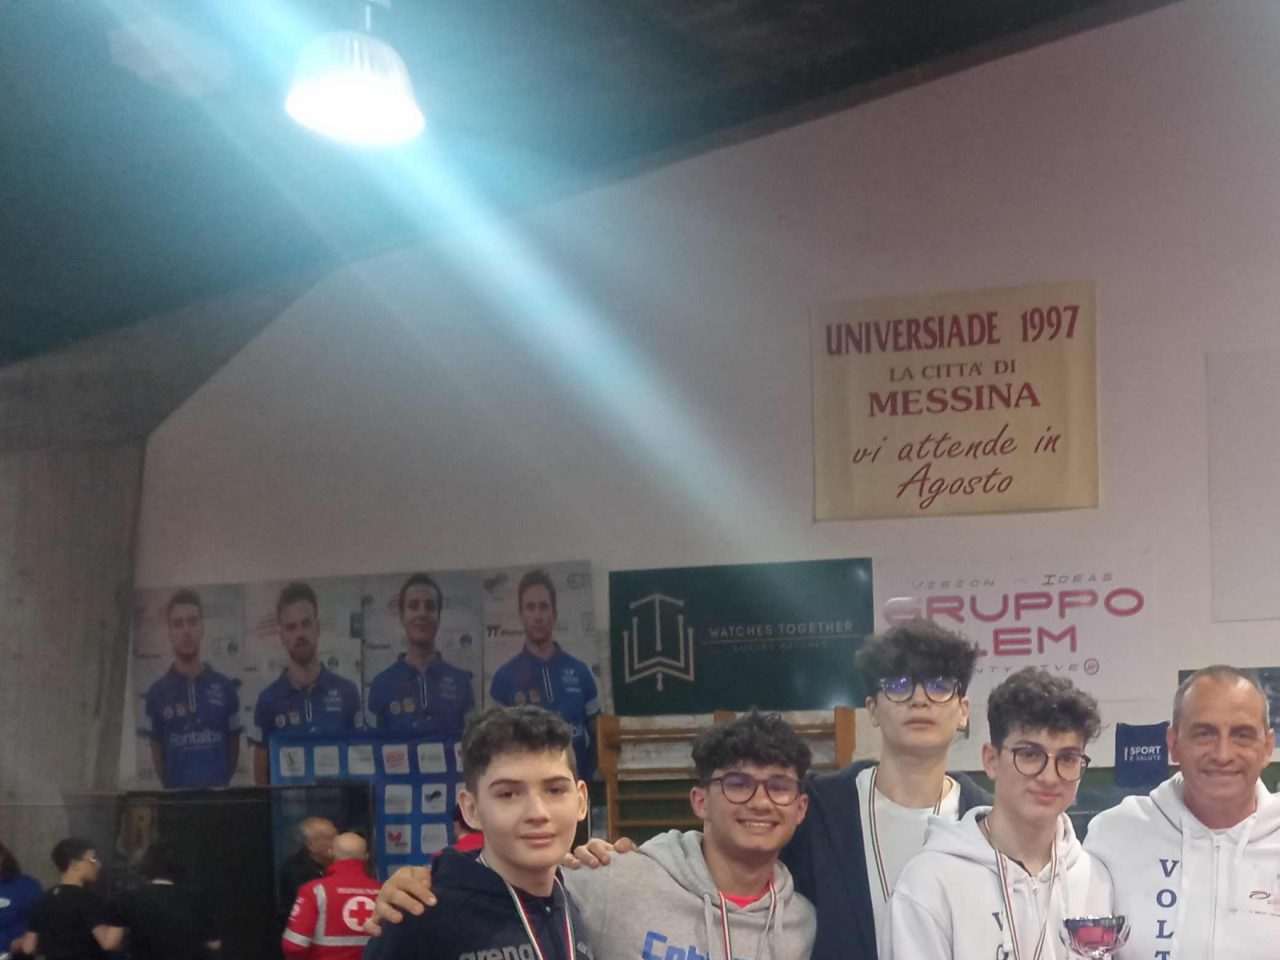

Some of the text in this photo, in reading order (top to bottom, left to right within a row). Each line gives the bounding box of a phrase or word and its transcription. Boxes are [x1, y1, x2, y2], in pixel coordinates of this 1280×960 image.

[826, 305, 1080, 356] UNIVERSIADE 1997
[890, 366, 913, 382] LA
[994, 359, 1016, 375] DI
[869, 382, 1041, 417] MESSINA
[853, 424, 1061, 464] vi attende in
[896, 463, 1013, 509] Agosto
[1041, 573, 1113, 586] IDEAS
[882, 587, 1144, 624] GRUPPO
[708, 620, 853, 638] WATCHES TOGETHER
[1130, 745, 1161, 755] SPORT
